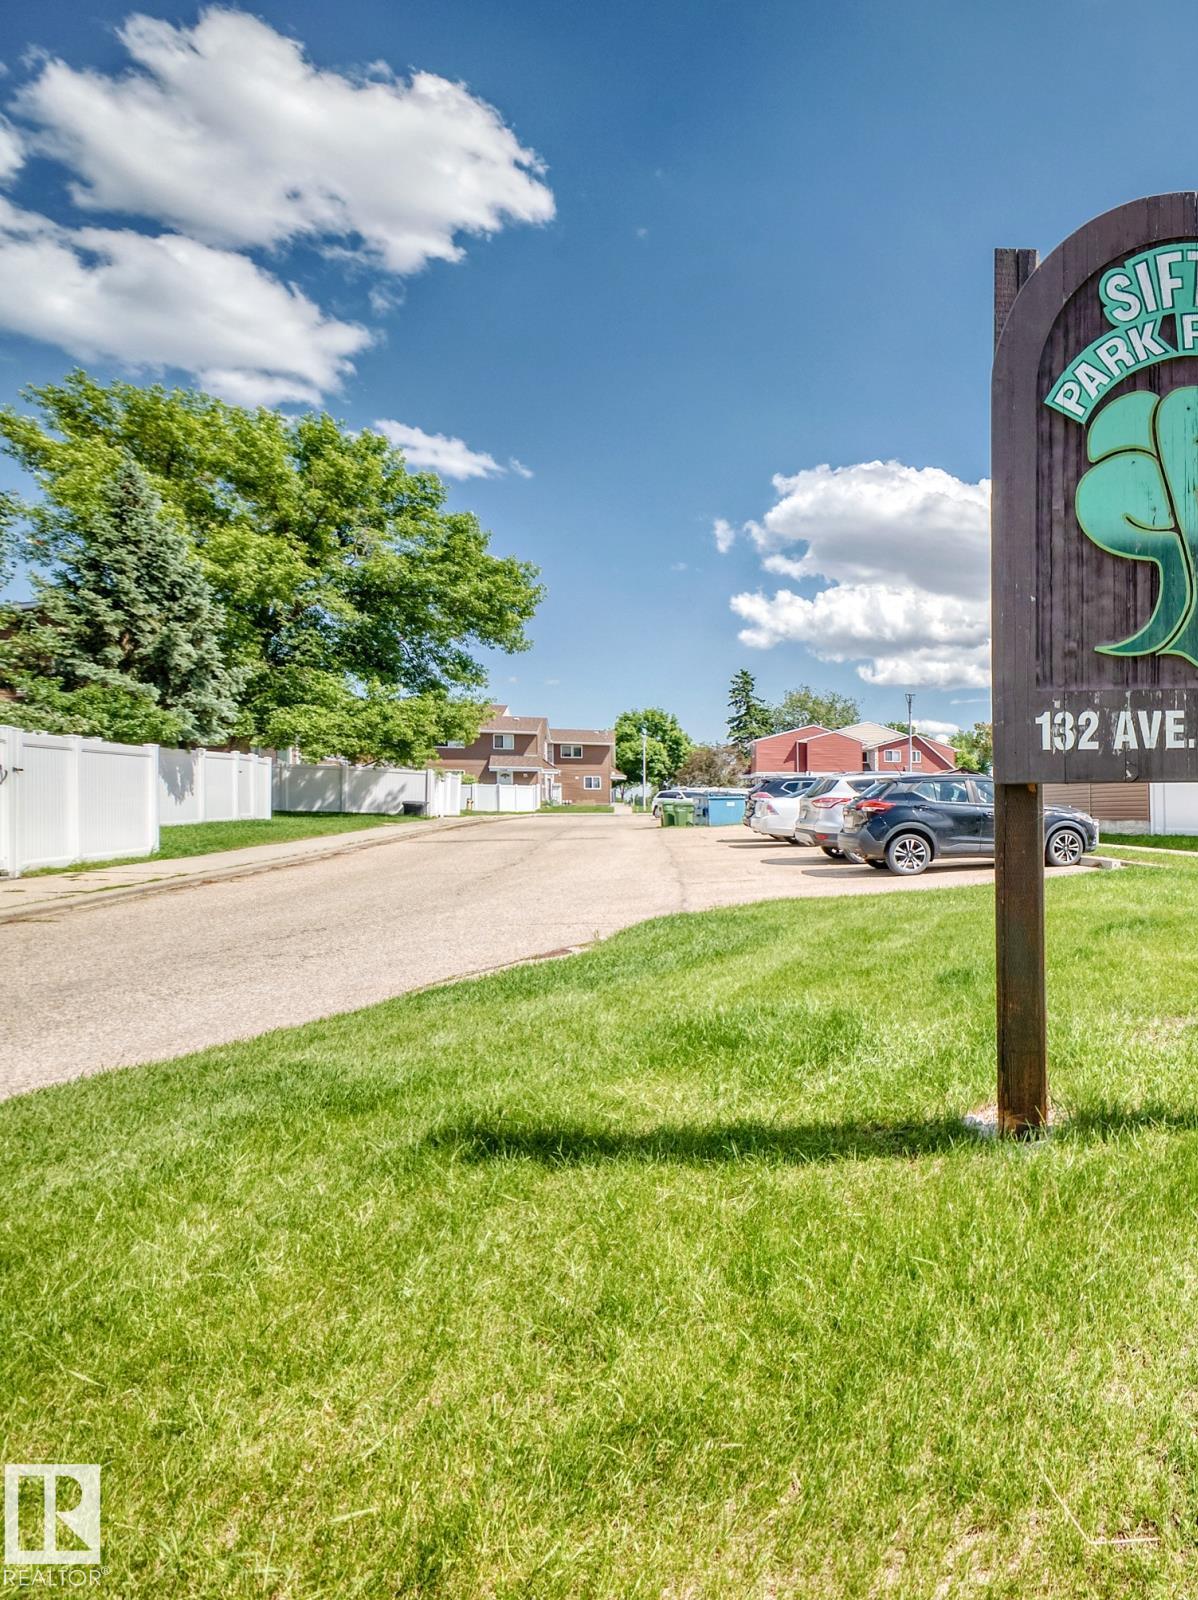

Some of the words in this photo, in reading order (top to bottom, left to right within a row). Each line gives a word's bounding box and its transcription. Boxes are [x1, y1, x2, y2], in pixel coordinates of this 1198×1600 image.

[1053, 320, 1166, 417] PARK
[1035, 710, 1100, 751] 132
[1113, 709, 1196, 750] AVE.
